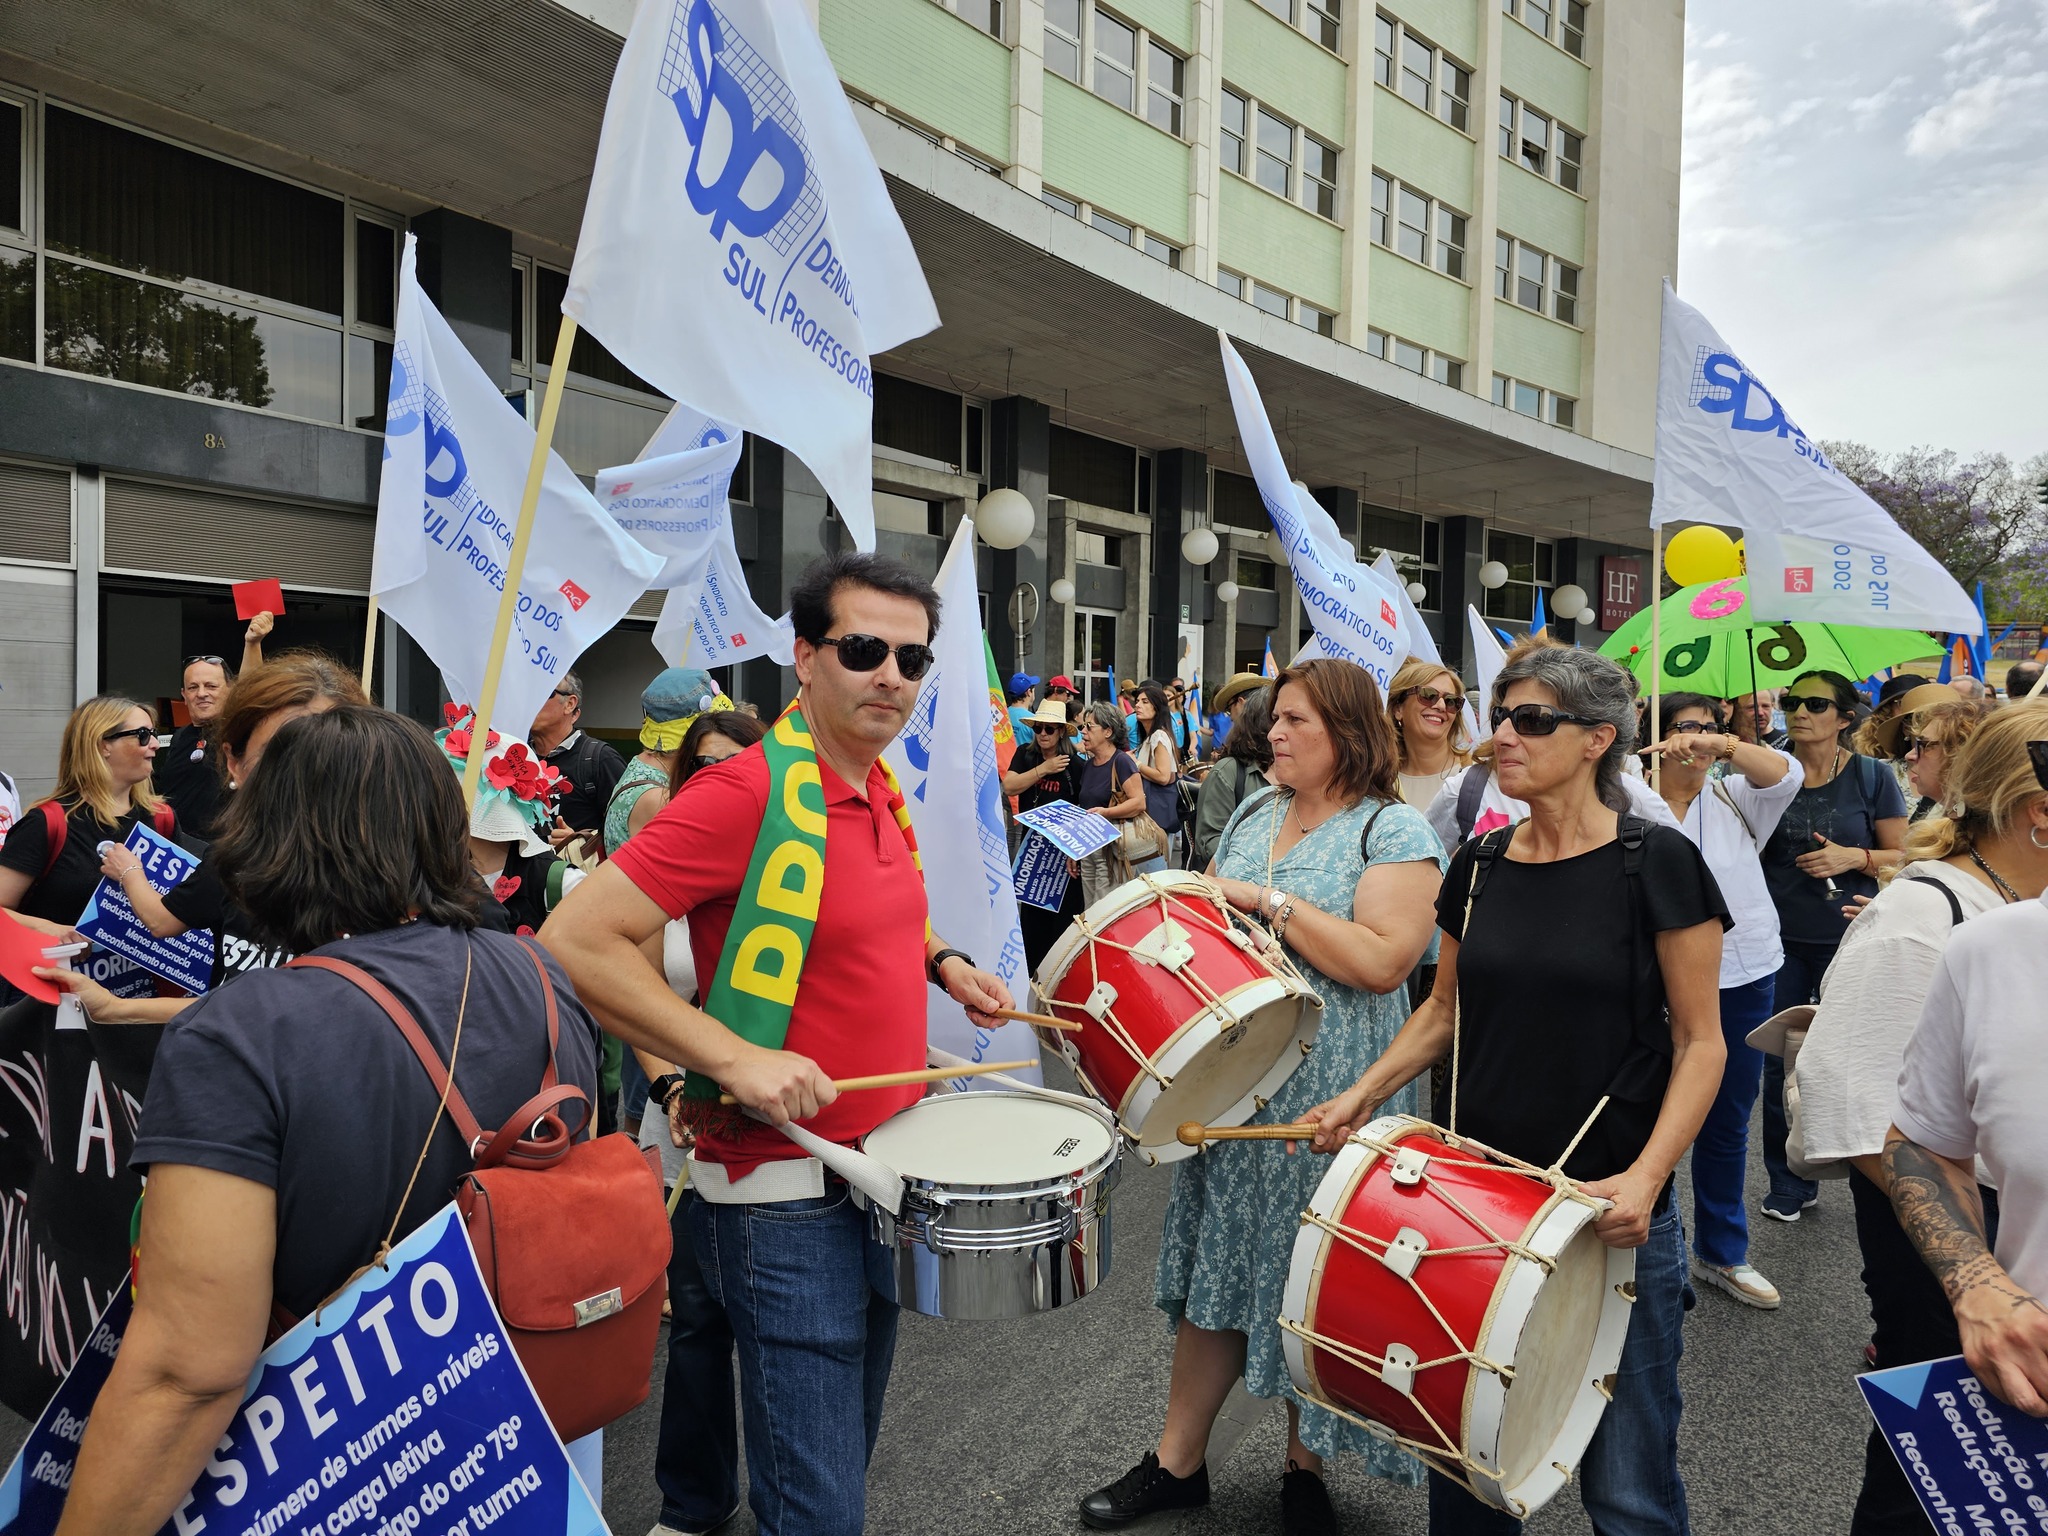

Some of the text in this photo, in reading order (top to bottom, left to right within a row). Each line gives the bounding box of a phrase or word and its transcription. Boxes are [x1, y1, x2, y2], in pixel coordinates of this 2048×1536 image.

[723, 243, 770, 317] SUL
[204, 433, 226, 449] 8A
[707, 577, 728, 616] SINDICATO
[1606, 570, 1638, 604] HF
[1606, 608, 1637, 619] HOTEL
[531, 645, 558, 674] SUL
[1014, 830, 1046, 896] VALORIZAÇÃ
[1024, 813, 1087, 855] VALORIZAÇÃO
[100, 899, 134, 923] Redução
[95, 927, 160, 967] Reconhecimento
[165, 964, 207, 990] autoridade
[125, 927, 191, 968] Menos Burocracia
[320, 1455, 347, 1489] de
[346, 1395, 422, 1466] turmas
[422, 1383, 437, 1406] e
[437, 1332, 499, 1395] níveis
[1957, 1377, 2034, 1490] Redução
[420, 1482, 450, 1516] do
[449, 1443, 486, 1492] artº
[486, 1415, 522, 1462] 79º
[1933, 1391, 2007, 1503] Redução
[327, 1475, 388, 1532] carga
[383, 1429, 446, 1490] letiva
[468, 1465, 542, 1535] turma
